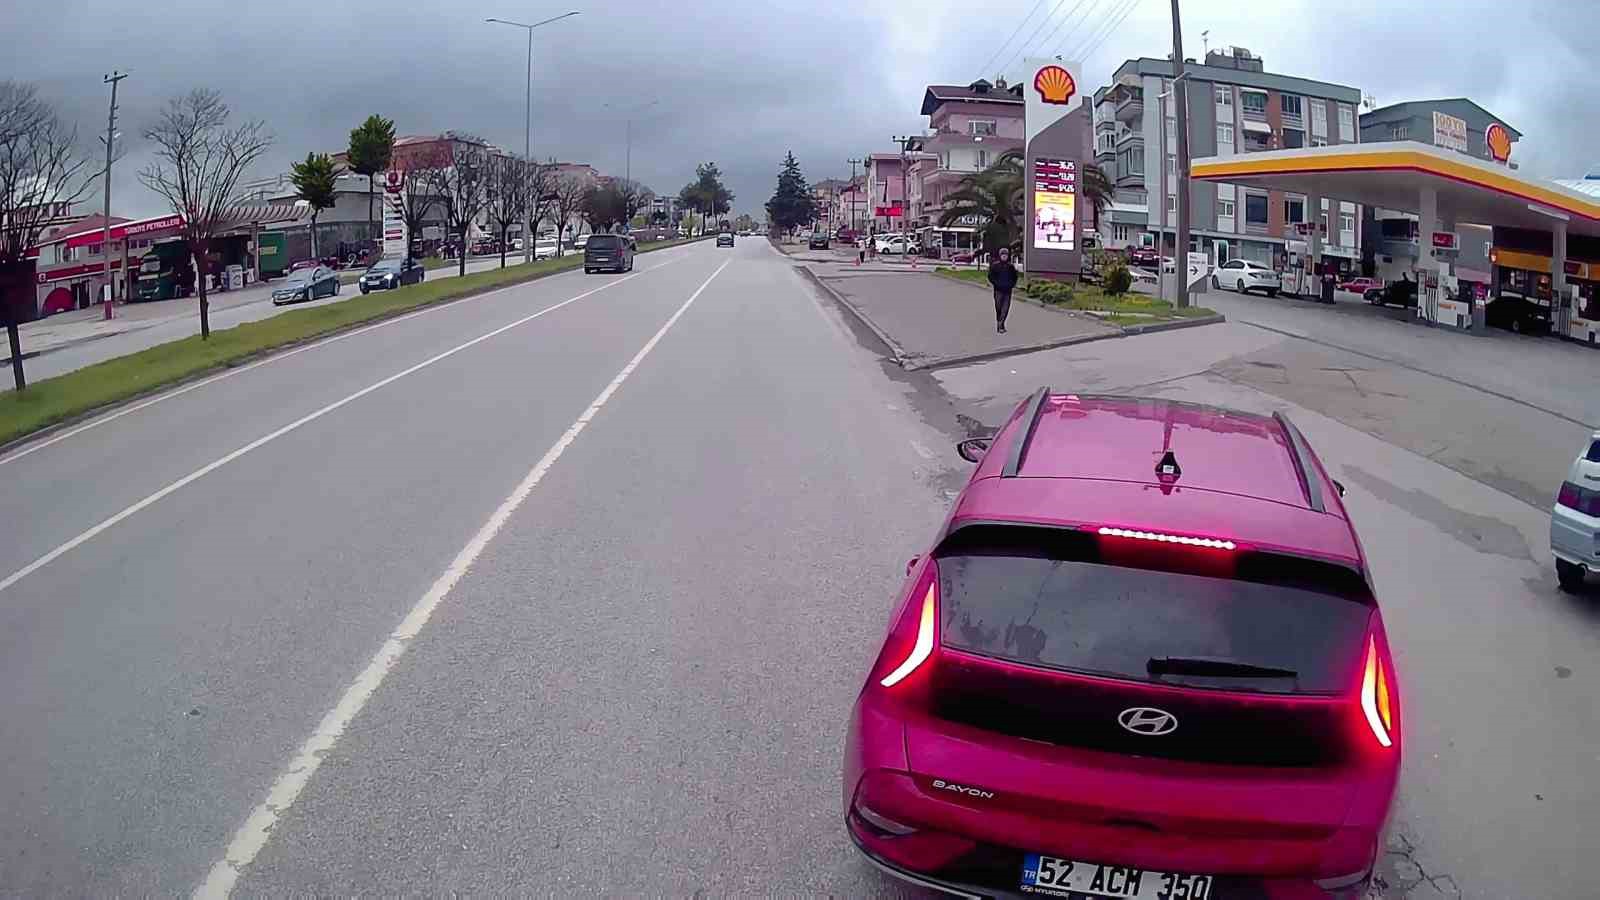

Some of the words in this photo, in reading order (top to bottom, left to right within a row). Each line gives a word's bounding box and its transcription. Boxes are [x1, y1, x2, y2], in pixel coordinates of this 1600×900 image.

[933, 780, 994, 798] BAYON
[1023, 869, 1037, 880] TR
[1038, 857, 1075, 887] 52
[1089, 864, 1144, 896] ACM
[1157, 872, 1211, 900] 350
